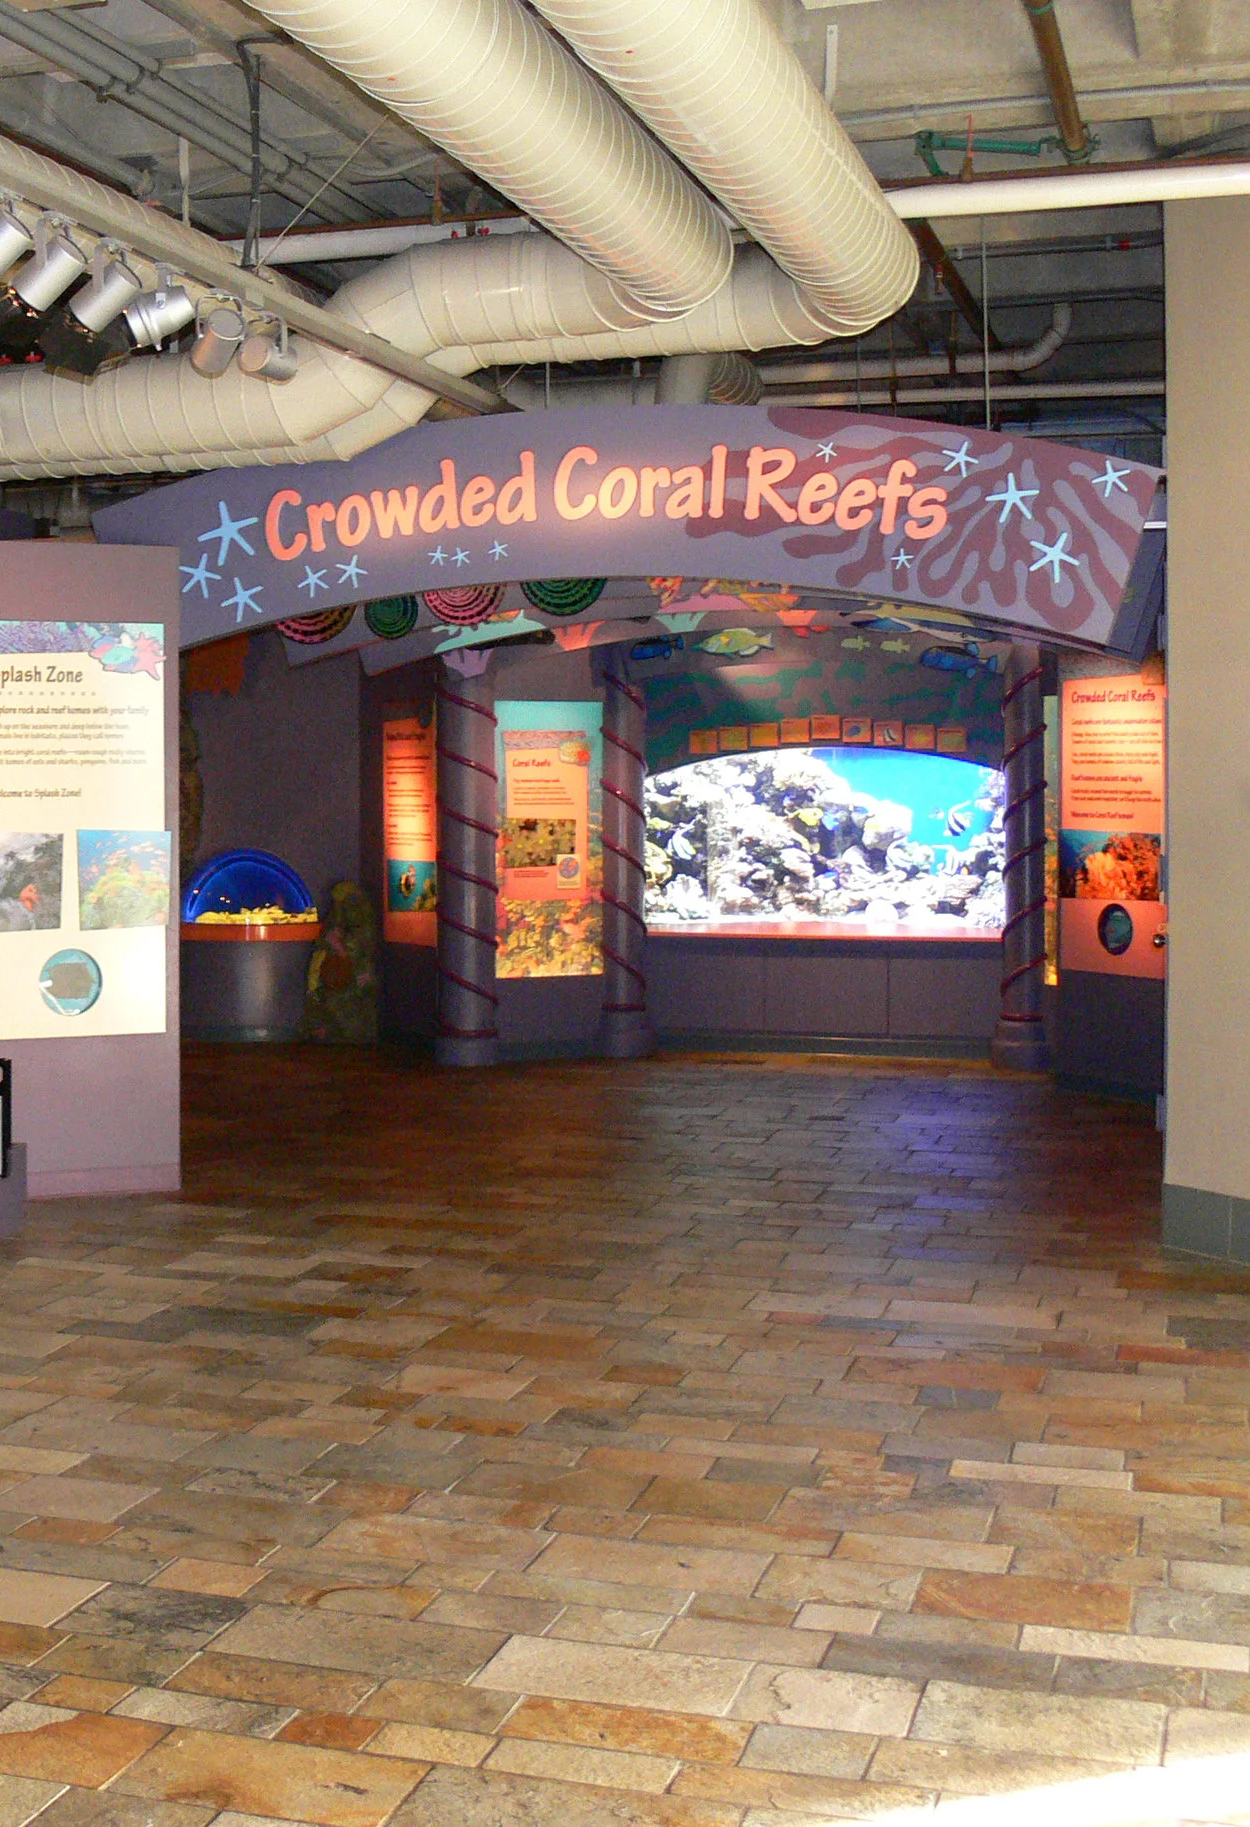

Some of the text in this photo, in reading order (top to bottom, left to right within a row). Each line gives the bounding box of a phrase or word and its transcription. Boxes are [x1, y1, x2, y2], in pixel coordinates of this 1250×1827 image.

[264, 442, 950, 563] Crowded Coral Reefs
[46, 665, 83, 683] Zone
[1071, 689, 1156, 703] Crowded Coral Reefs
[18, 705, 34, 714] rock
[36, 705, 50, 714] and
[51, 705, 67, 714] reef
[24, 789, 33, 798] to
[34, 788, 60, 800] Splash
[61, 788, 82, 798] Zone!
